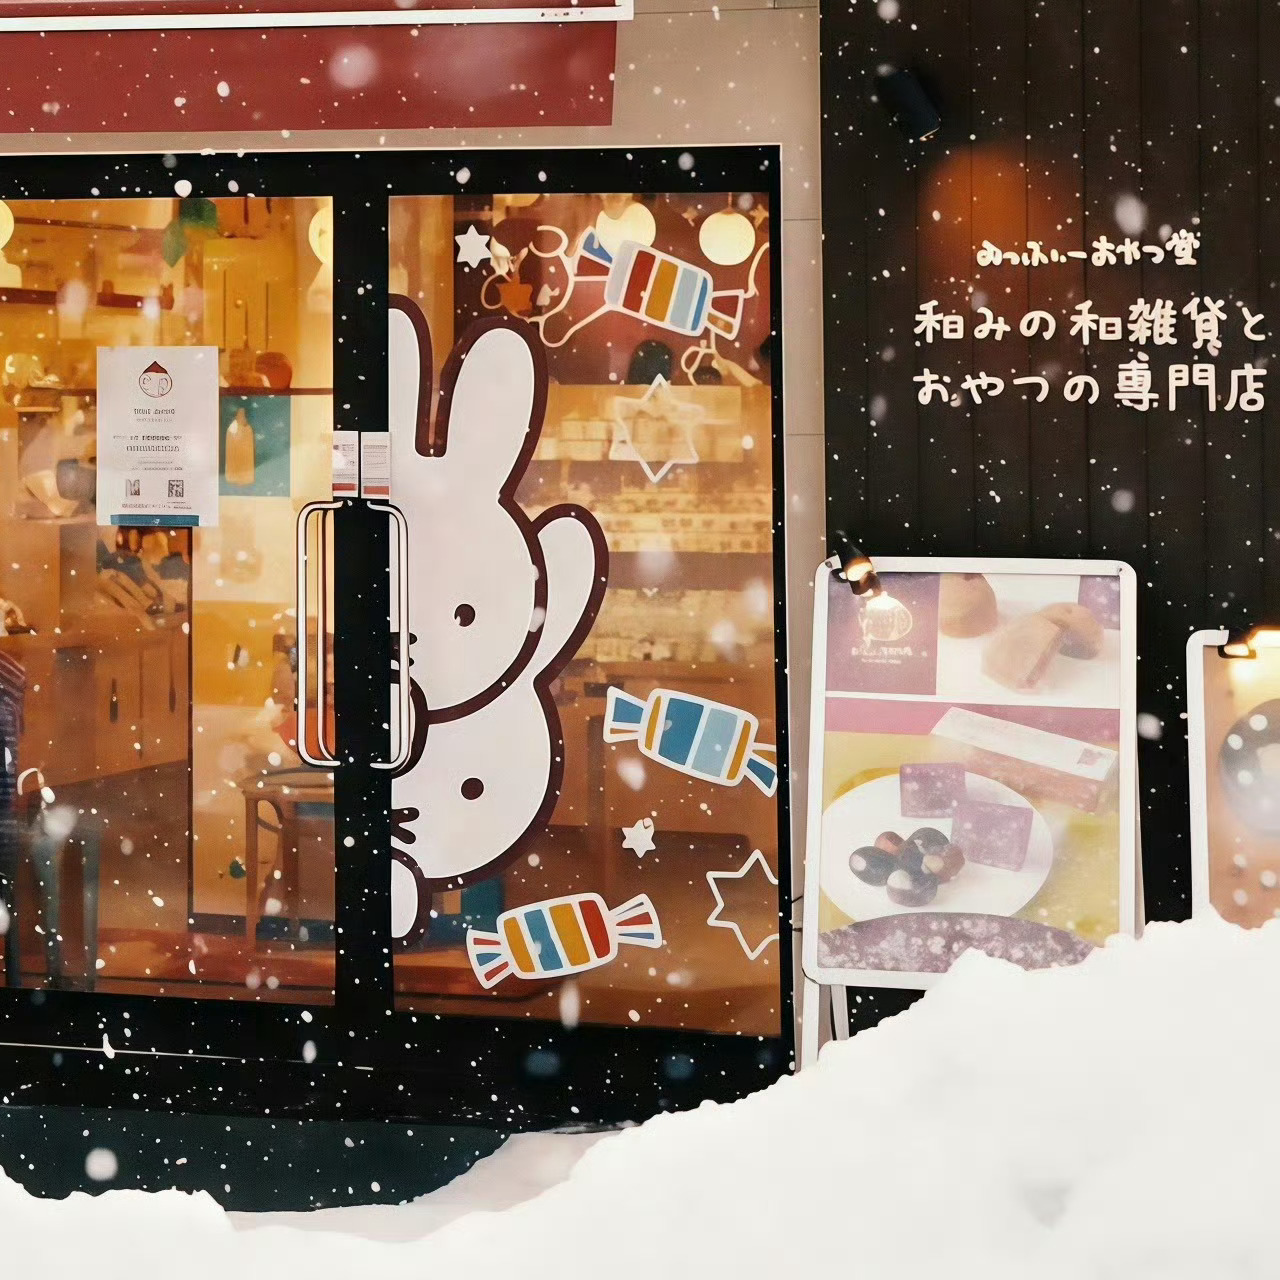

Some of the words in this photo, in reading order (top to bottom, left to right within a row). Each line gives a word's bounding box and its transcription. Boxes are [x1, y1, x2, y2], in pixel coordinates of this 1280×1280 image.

[913, 296, 1267, 351] 和みの和雑貨と
[913, 357, 1268, 412] おやつの専門店
